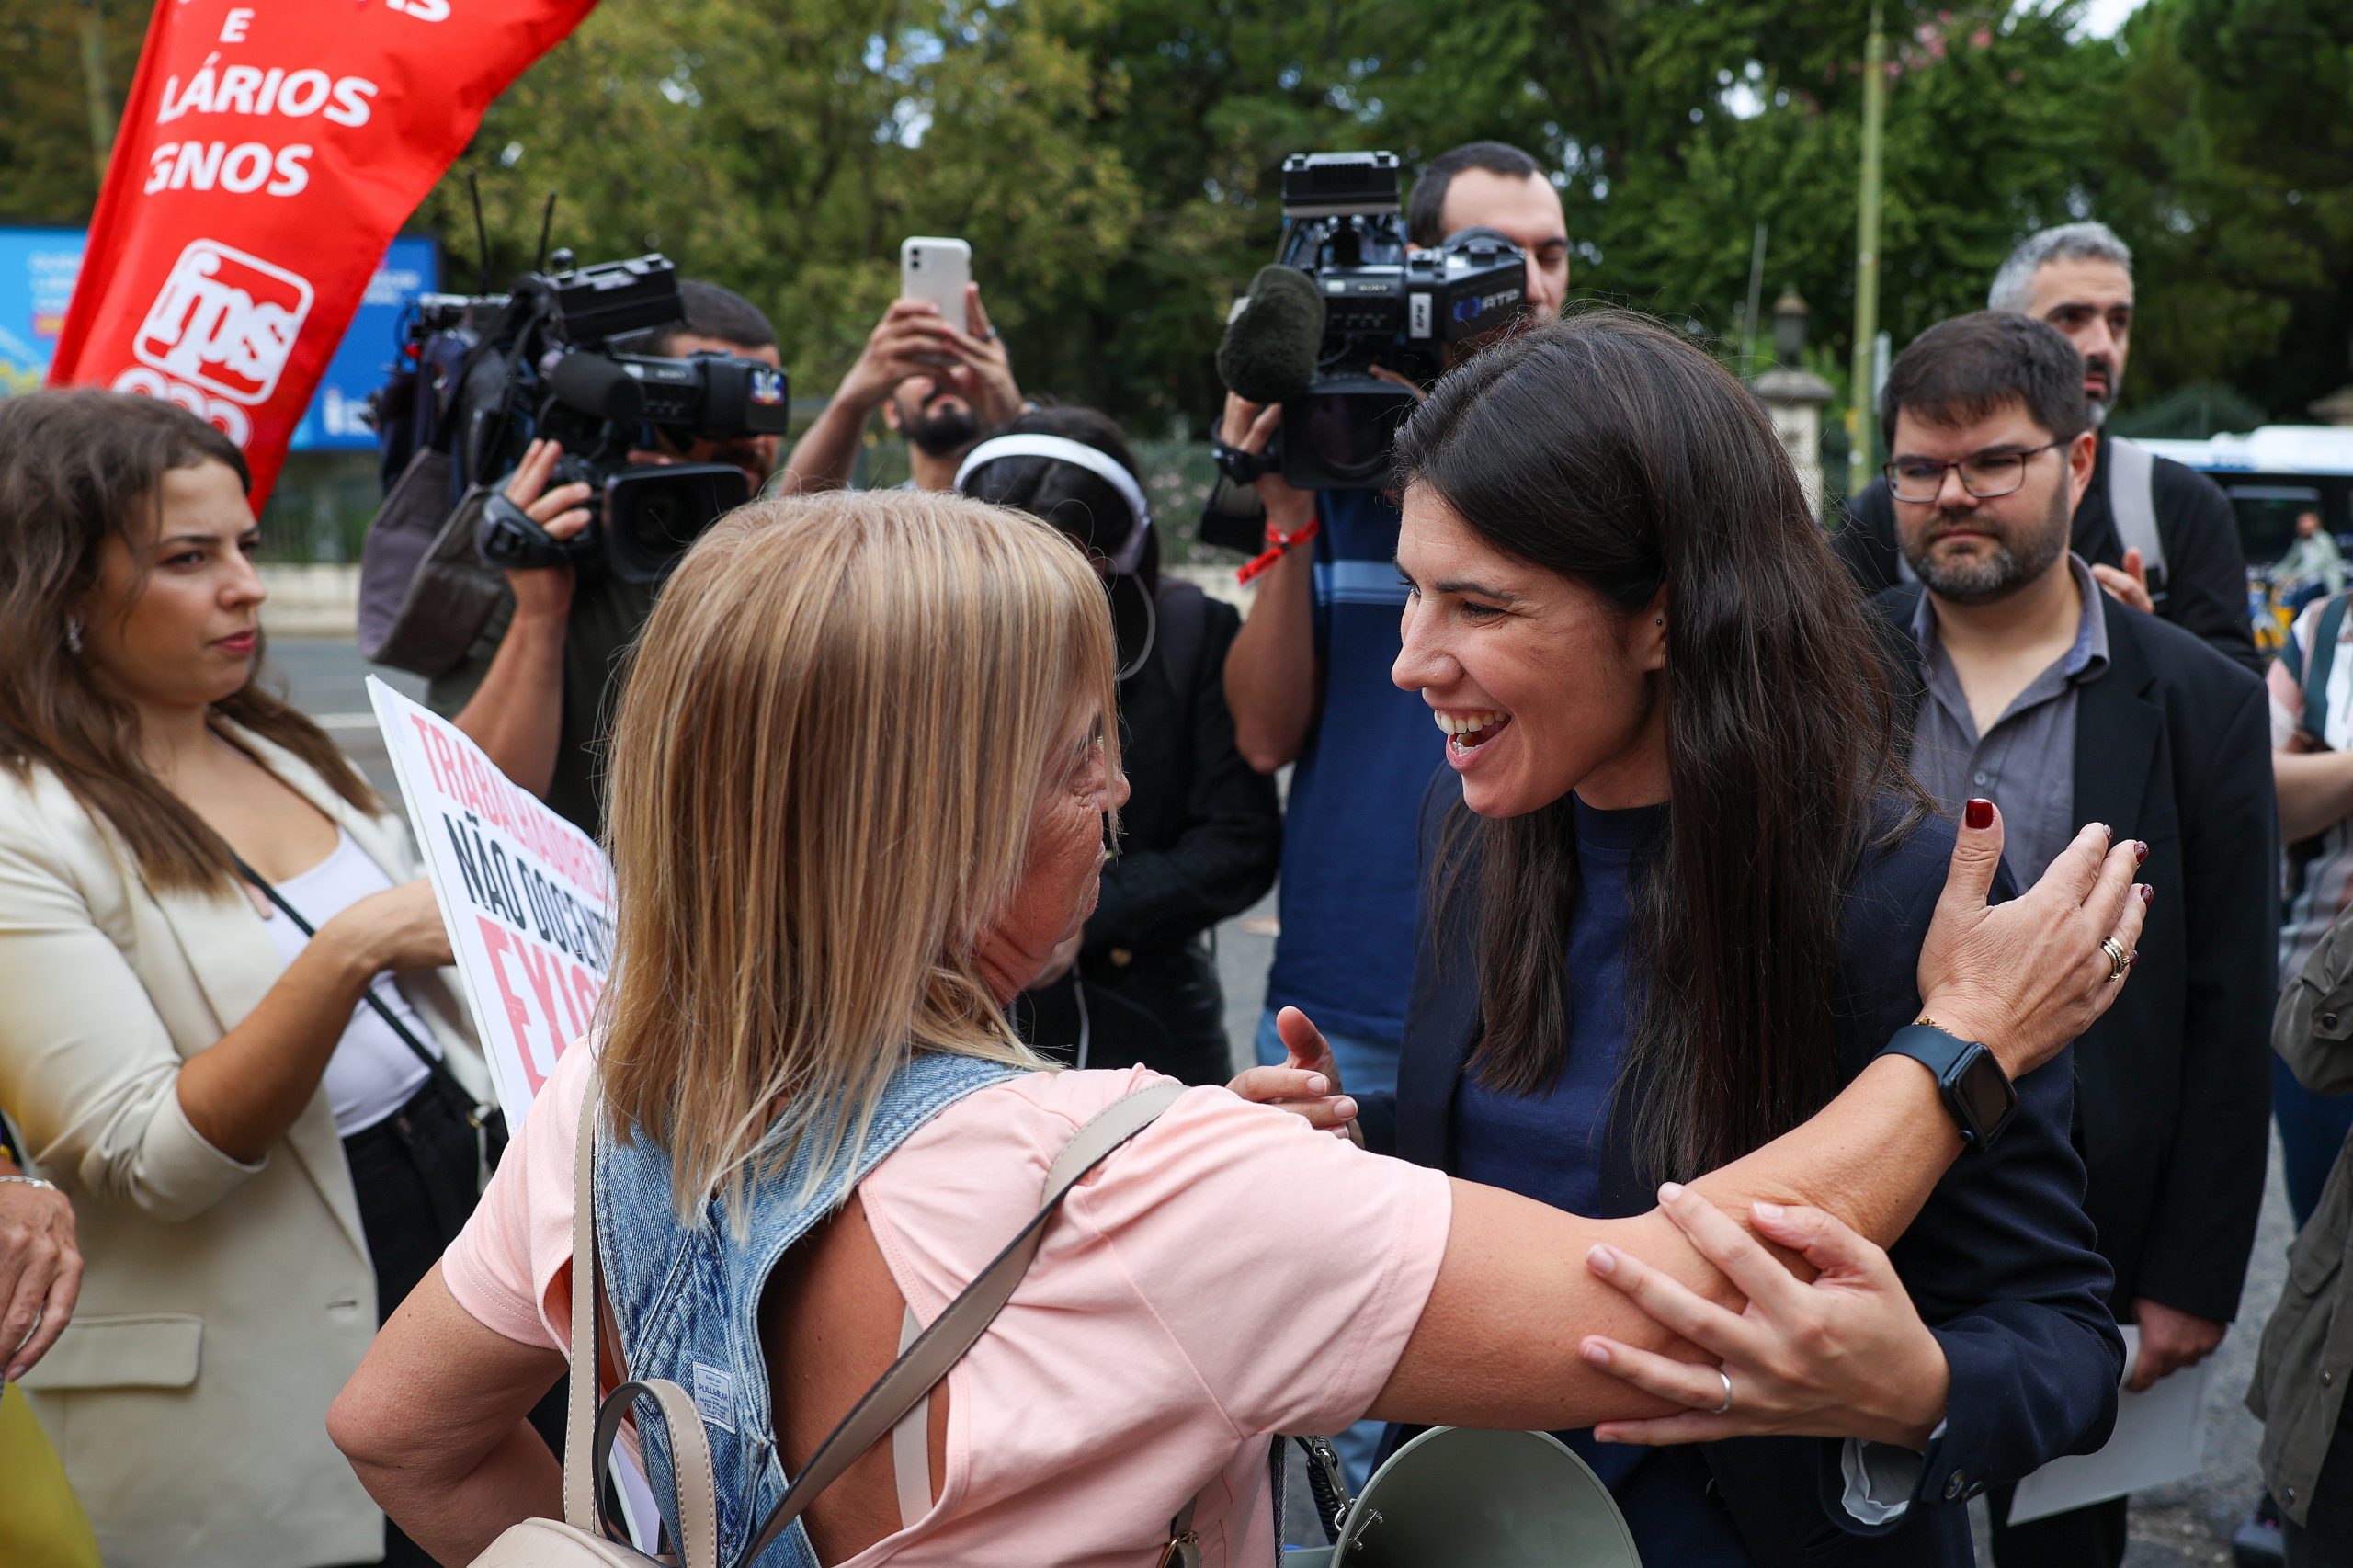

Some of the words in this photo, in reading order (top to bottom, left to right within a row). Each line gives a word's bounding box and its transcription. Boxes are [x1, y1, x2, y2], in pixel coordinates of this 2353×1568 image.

[219, 8, 256, 43] E
[156, 51, 379, 128] LÁRIOS
[442, 811, 526, 930] NÃO
